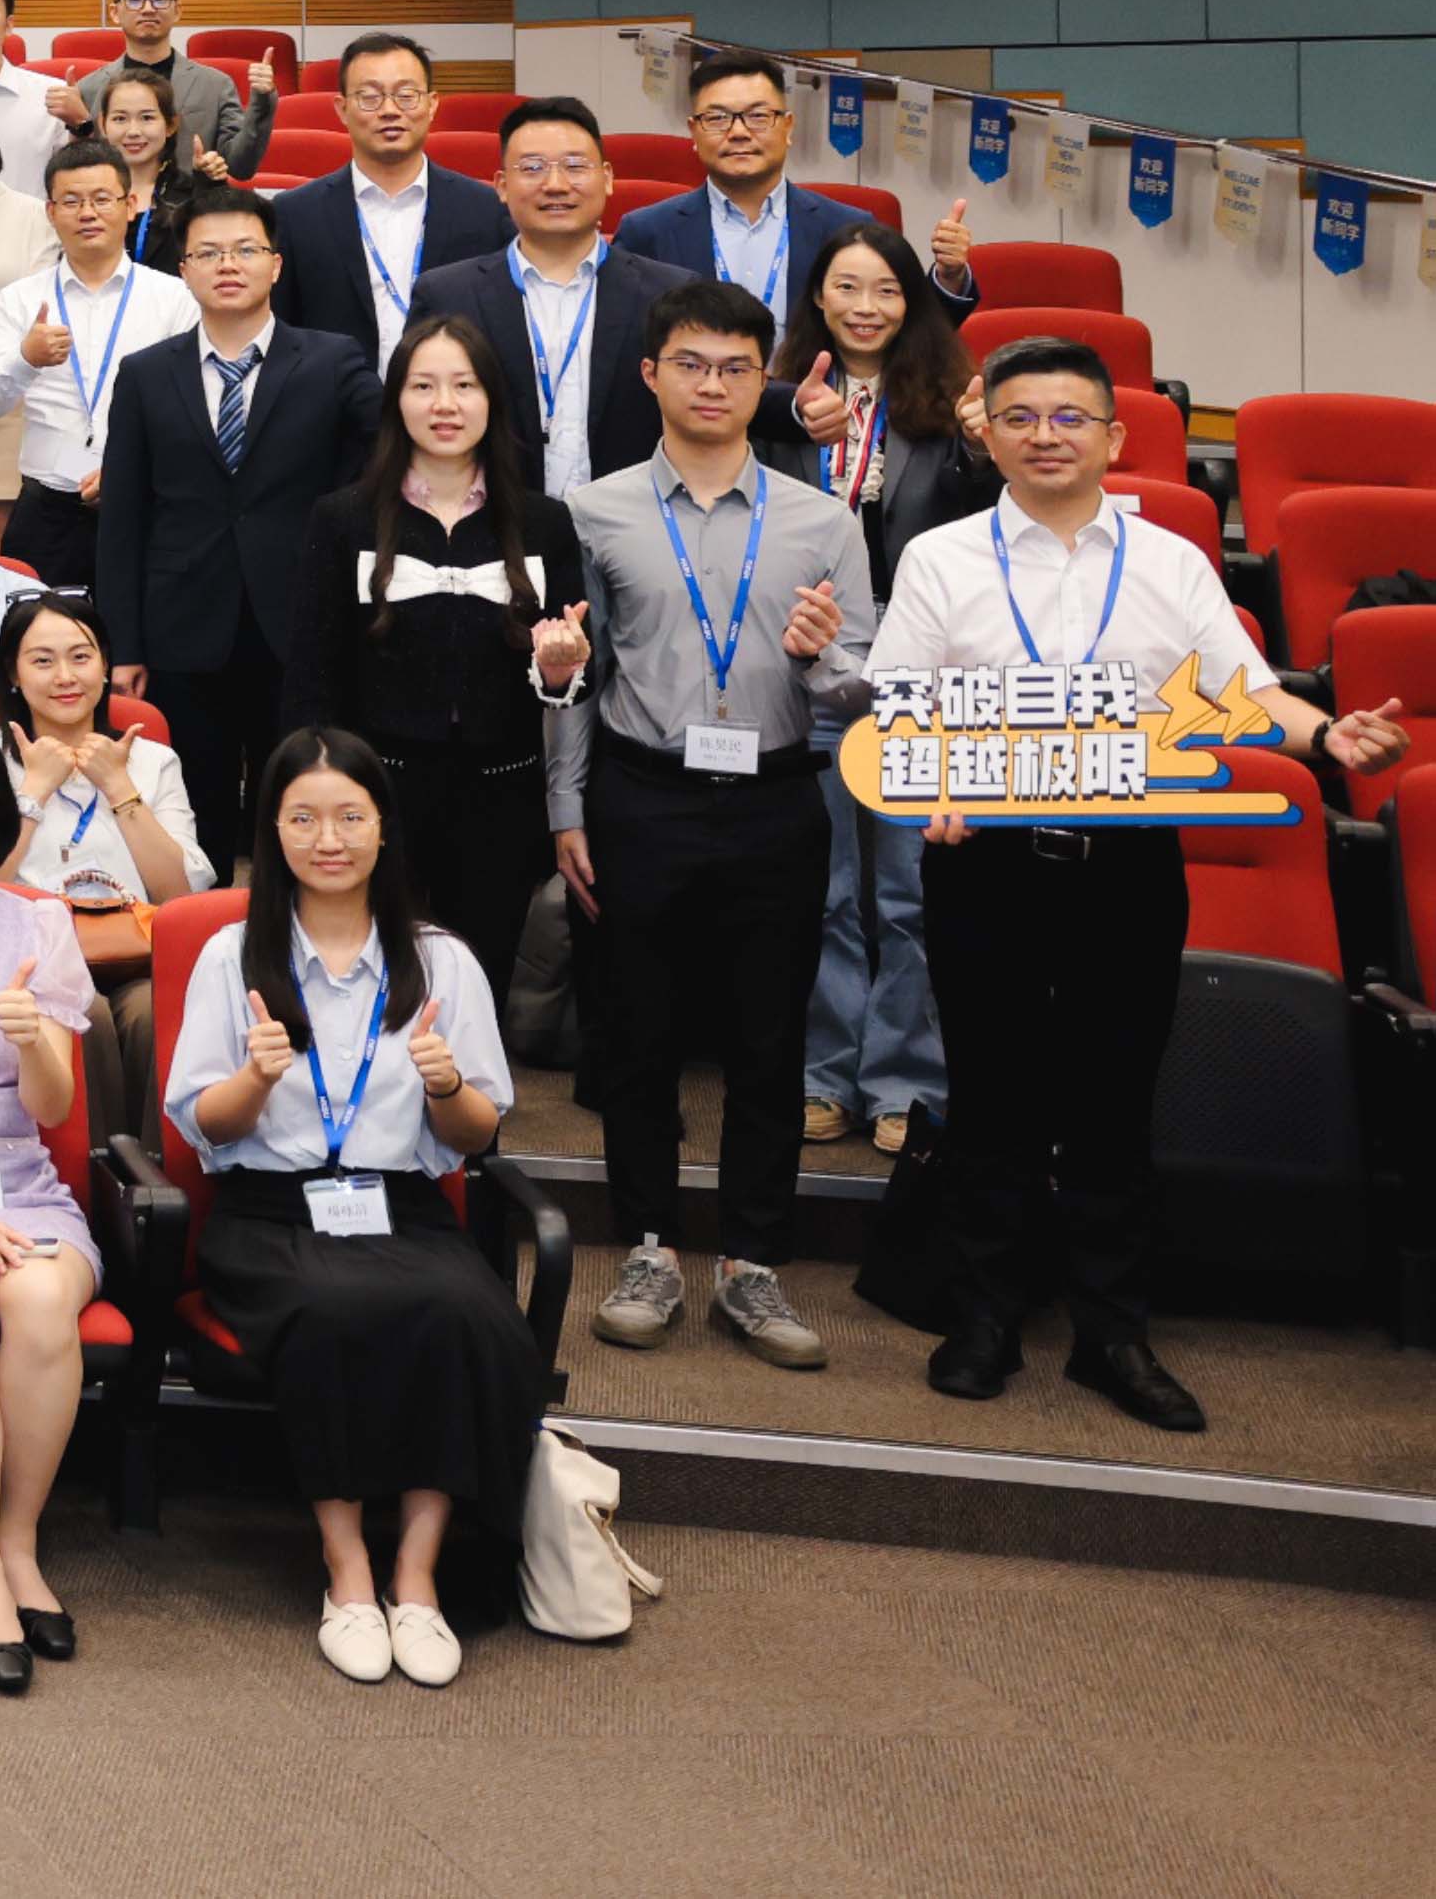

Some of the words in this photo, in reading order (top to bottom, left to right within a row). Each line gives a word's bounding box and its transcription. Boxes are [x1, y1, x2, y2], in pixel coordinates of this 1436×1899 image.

[1139, 157, 1163, 176] 欢迎
[1133, 176, 1169, 196] 新同学
[1327, 199, 1355, 220] 欢迎
[1321, 216, 1360, 242] 新同学
[871, 660, 1138, 732] 突破自我
[879, 733, 1147, 802] 超越极限
